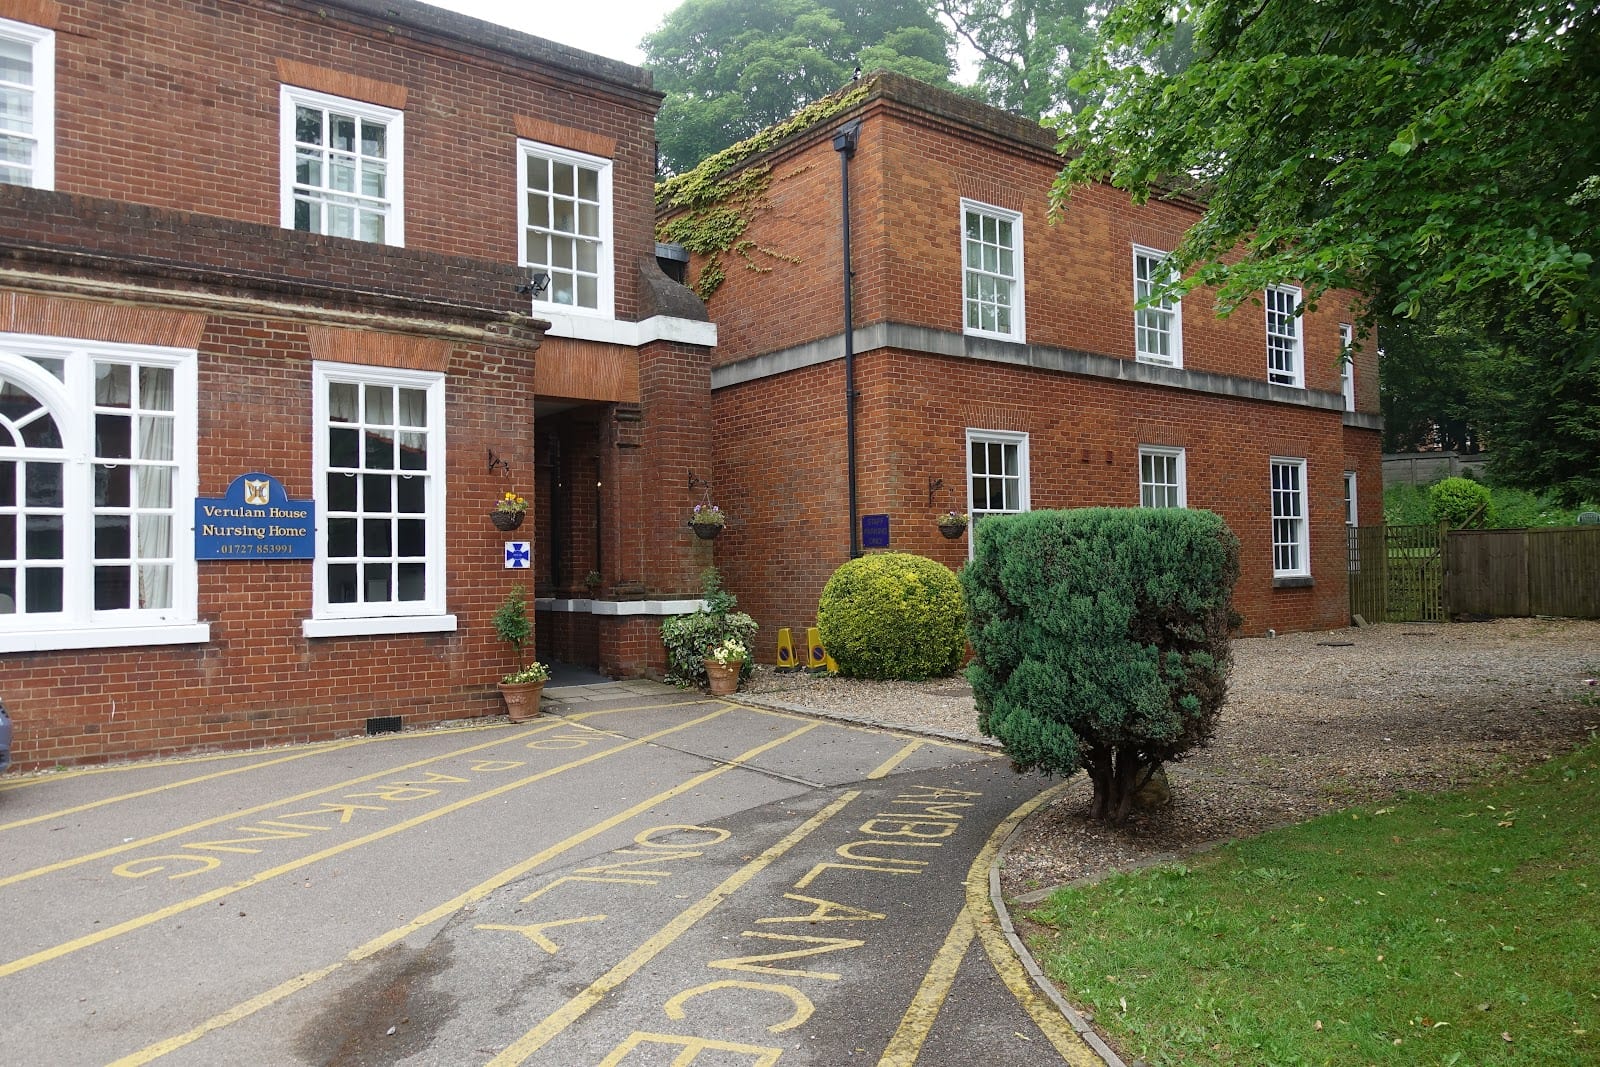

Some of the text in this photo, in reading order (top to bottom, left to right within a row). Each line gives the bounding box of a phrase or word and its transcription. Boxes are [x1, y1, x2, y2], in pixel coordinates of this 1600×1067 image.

[202, 524, 307, 539] Nursing Home
[203, 506, 308, 519] Verulam House
[221, 545, 292, 554] 01727 853991
[111, 729, 625, 879] NO PARKING
[473, 824, 732, 955] ONLY
[598, 785, 983, 1067] AMBULANCE
